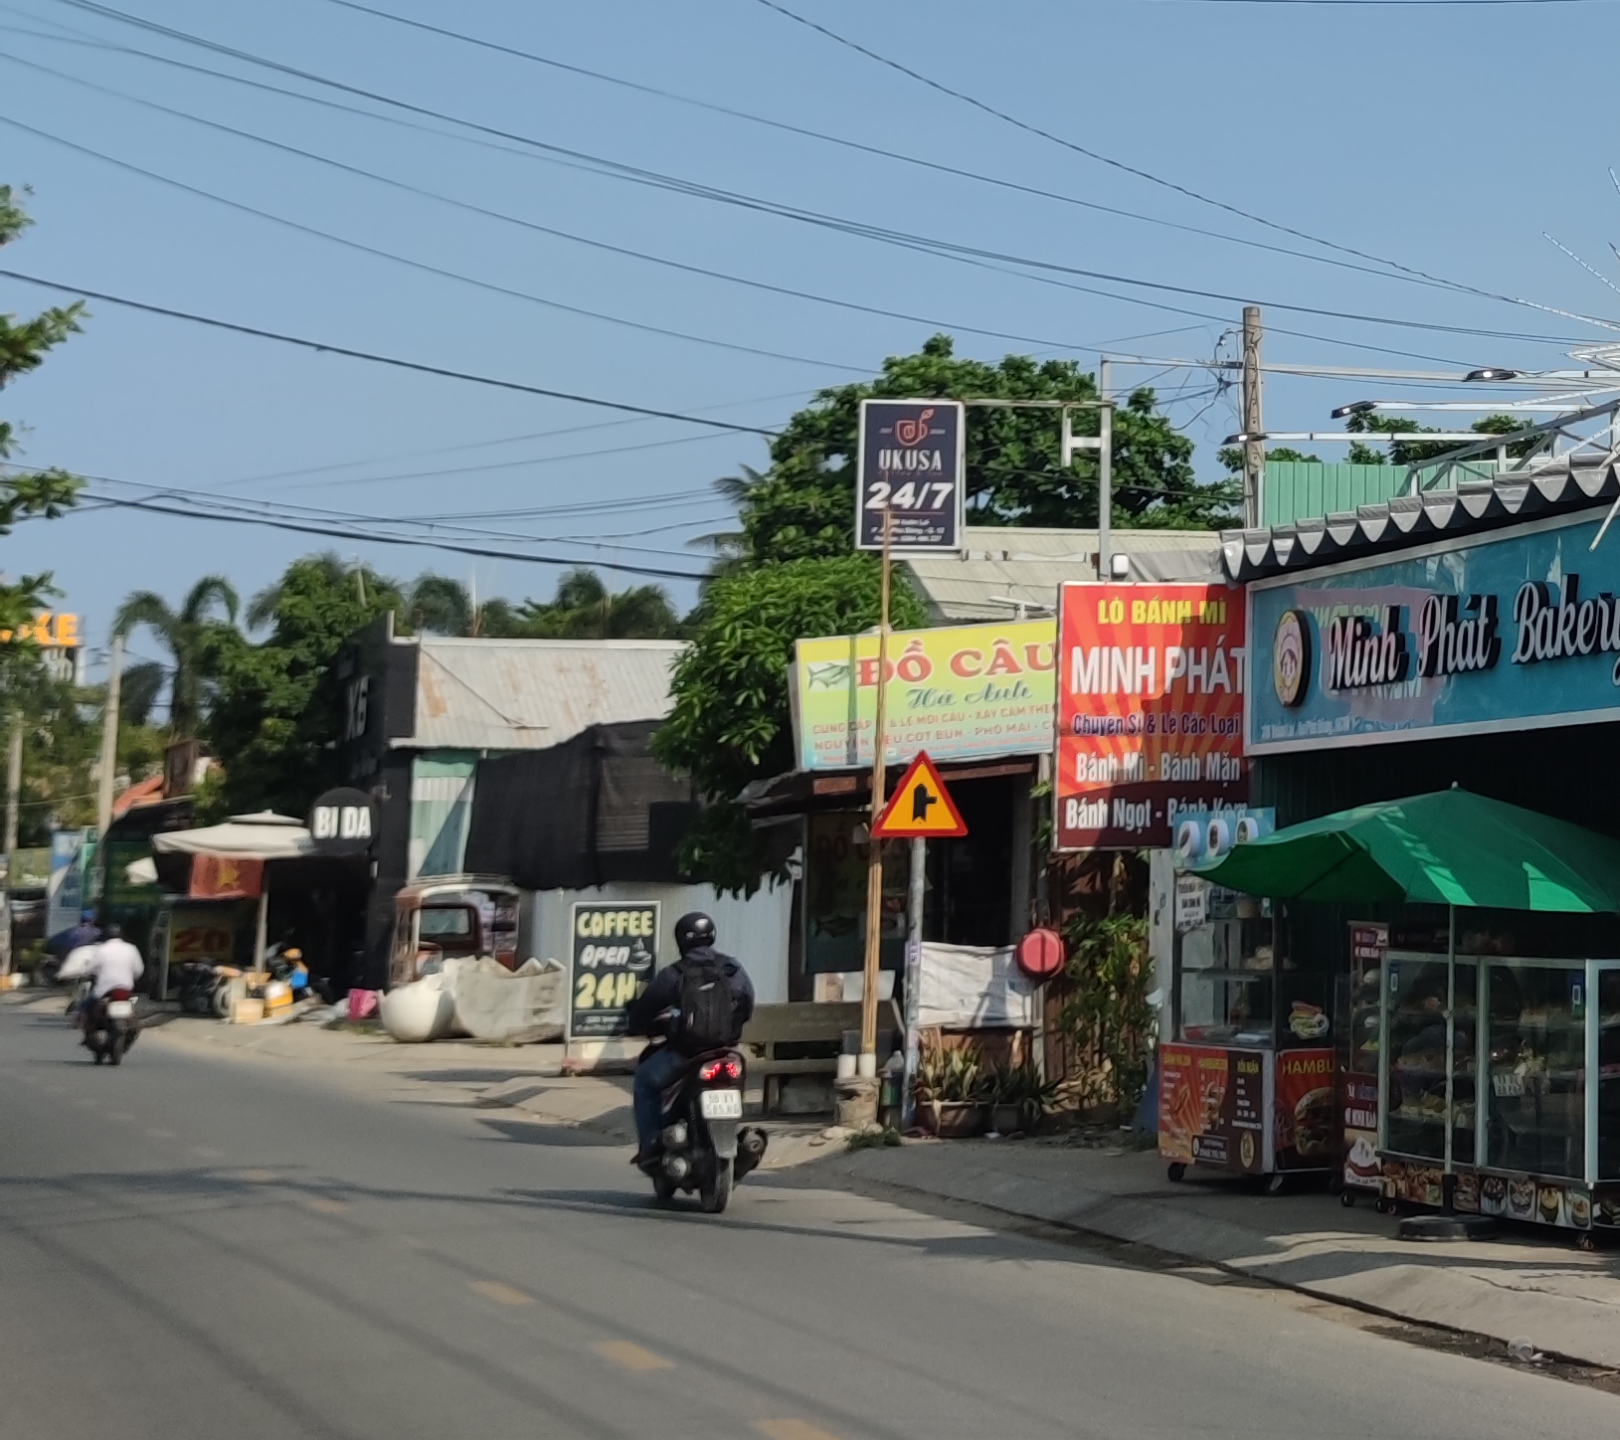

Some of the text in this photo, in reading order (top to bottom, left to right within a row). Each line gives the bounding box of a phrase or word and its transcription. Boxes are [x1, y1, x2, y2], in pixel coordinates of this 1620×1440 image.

[865, 481, 954, 510] 24/7
[1097, 595, 1227, 625] LÒ BÁNH MÌ
[1328, 606, 1405, 690] Minh
[1418, 594, 1497, 677] Phát
[856, 638, 1057, 687] ĐỒ CÂU
[1070, 634, 1246, 695] MINH PHÁT
[1073, 712, 1125, 736] Chuyên
[1211, 713, 1240, 738] Loại
[1076, 751, 1119, 782] Bánh
[1161, 751, 1200, 781] Bánh
[313, 806, 372, 839] BI DA
[1065, 797, 1109, 830] Bánh
[1112, 798, 1152, 835] Ngọt
[576, 910, 654, 938] COFFEE
[579, 944, 631, 969] Open
